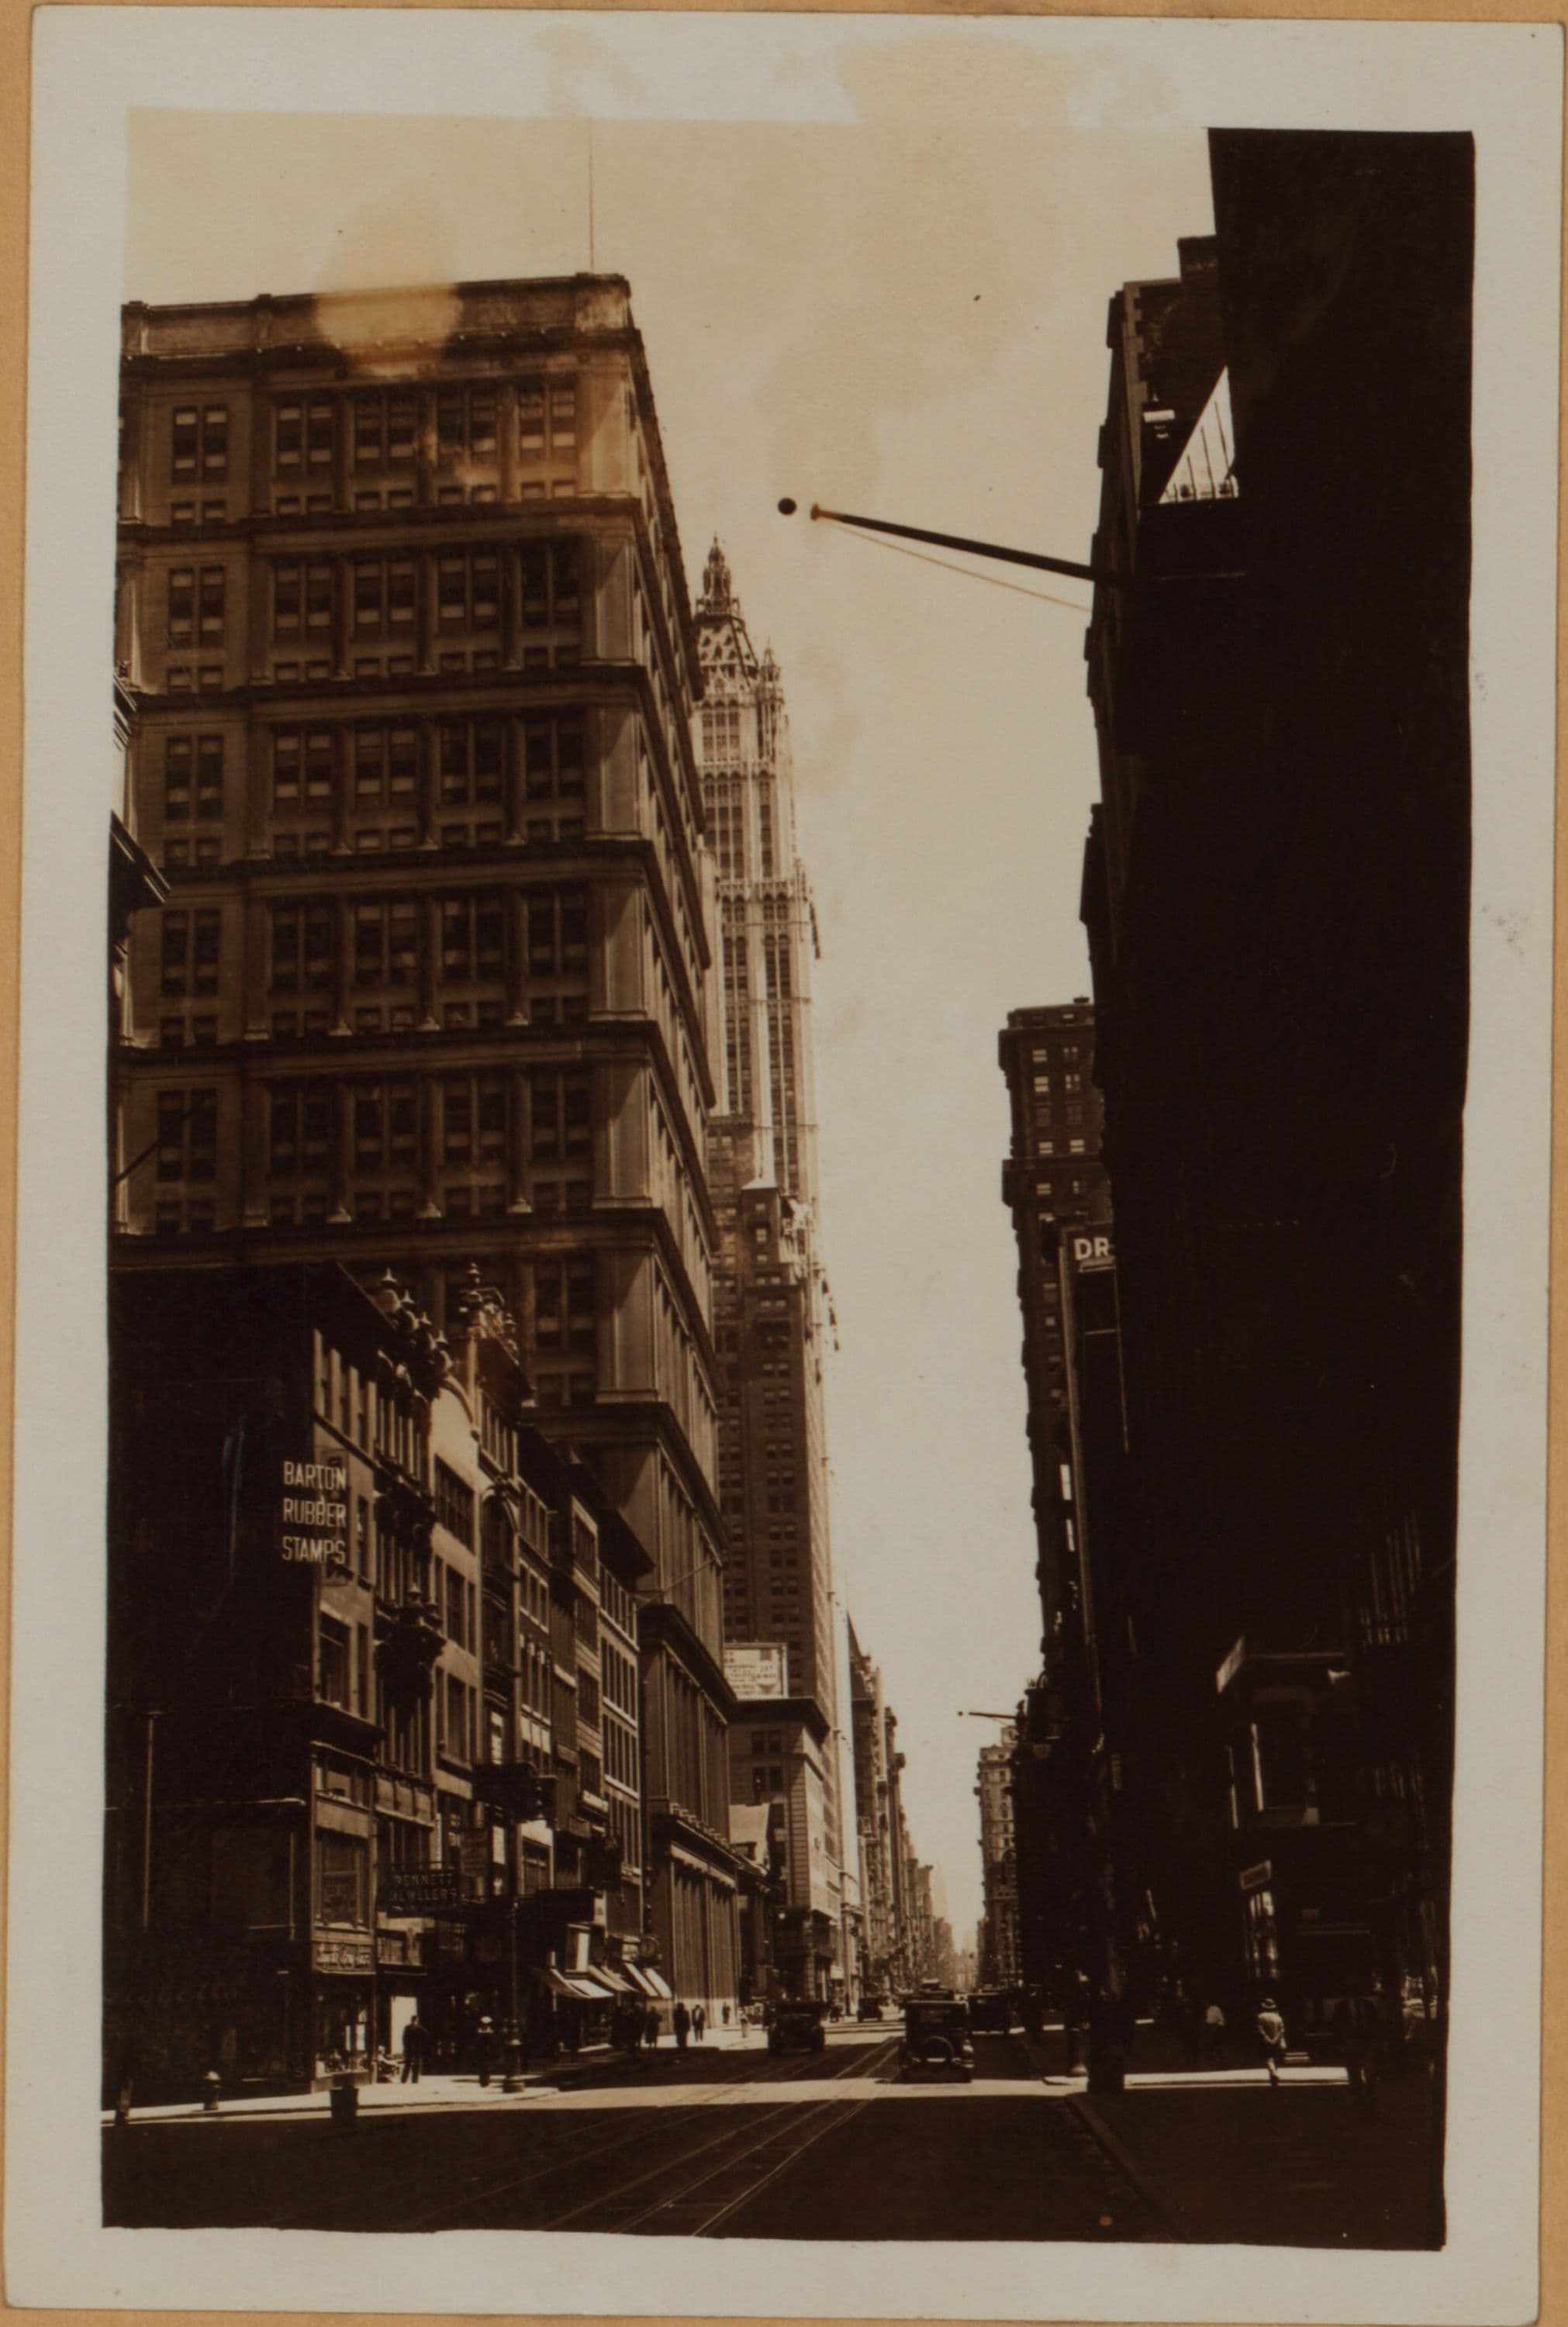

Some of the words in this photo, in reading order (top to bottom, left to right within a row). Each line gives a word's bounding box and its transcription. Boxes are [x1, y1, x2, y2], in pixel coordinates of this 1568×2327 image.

[284, 1461, 347, 1491] BARTON
[283, 1497, 347, 1528] RUBBER
[281, 1535, 346, 1565] STAMPS
